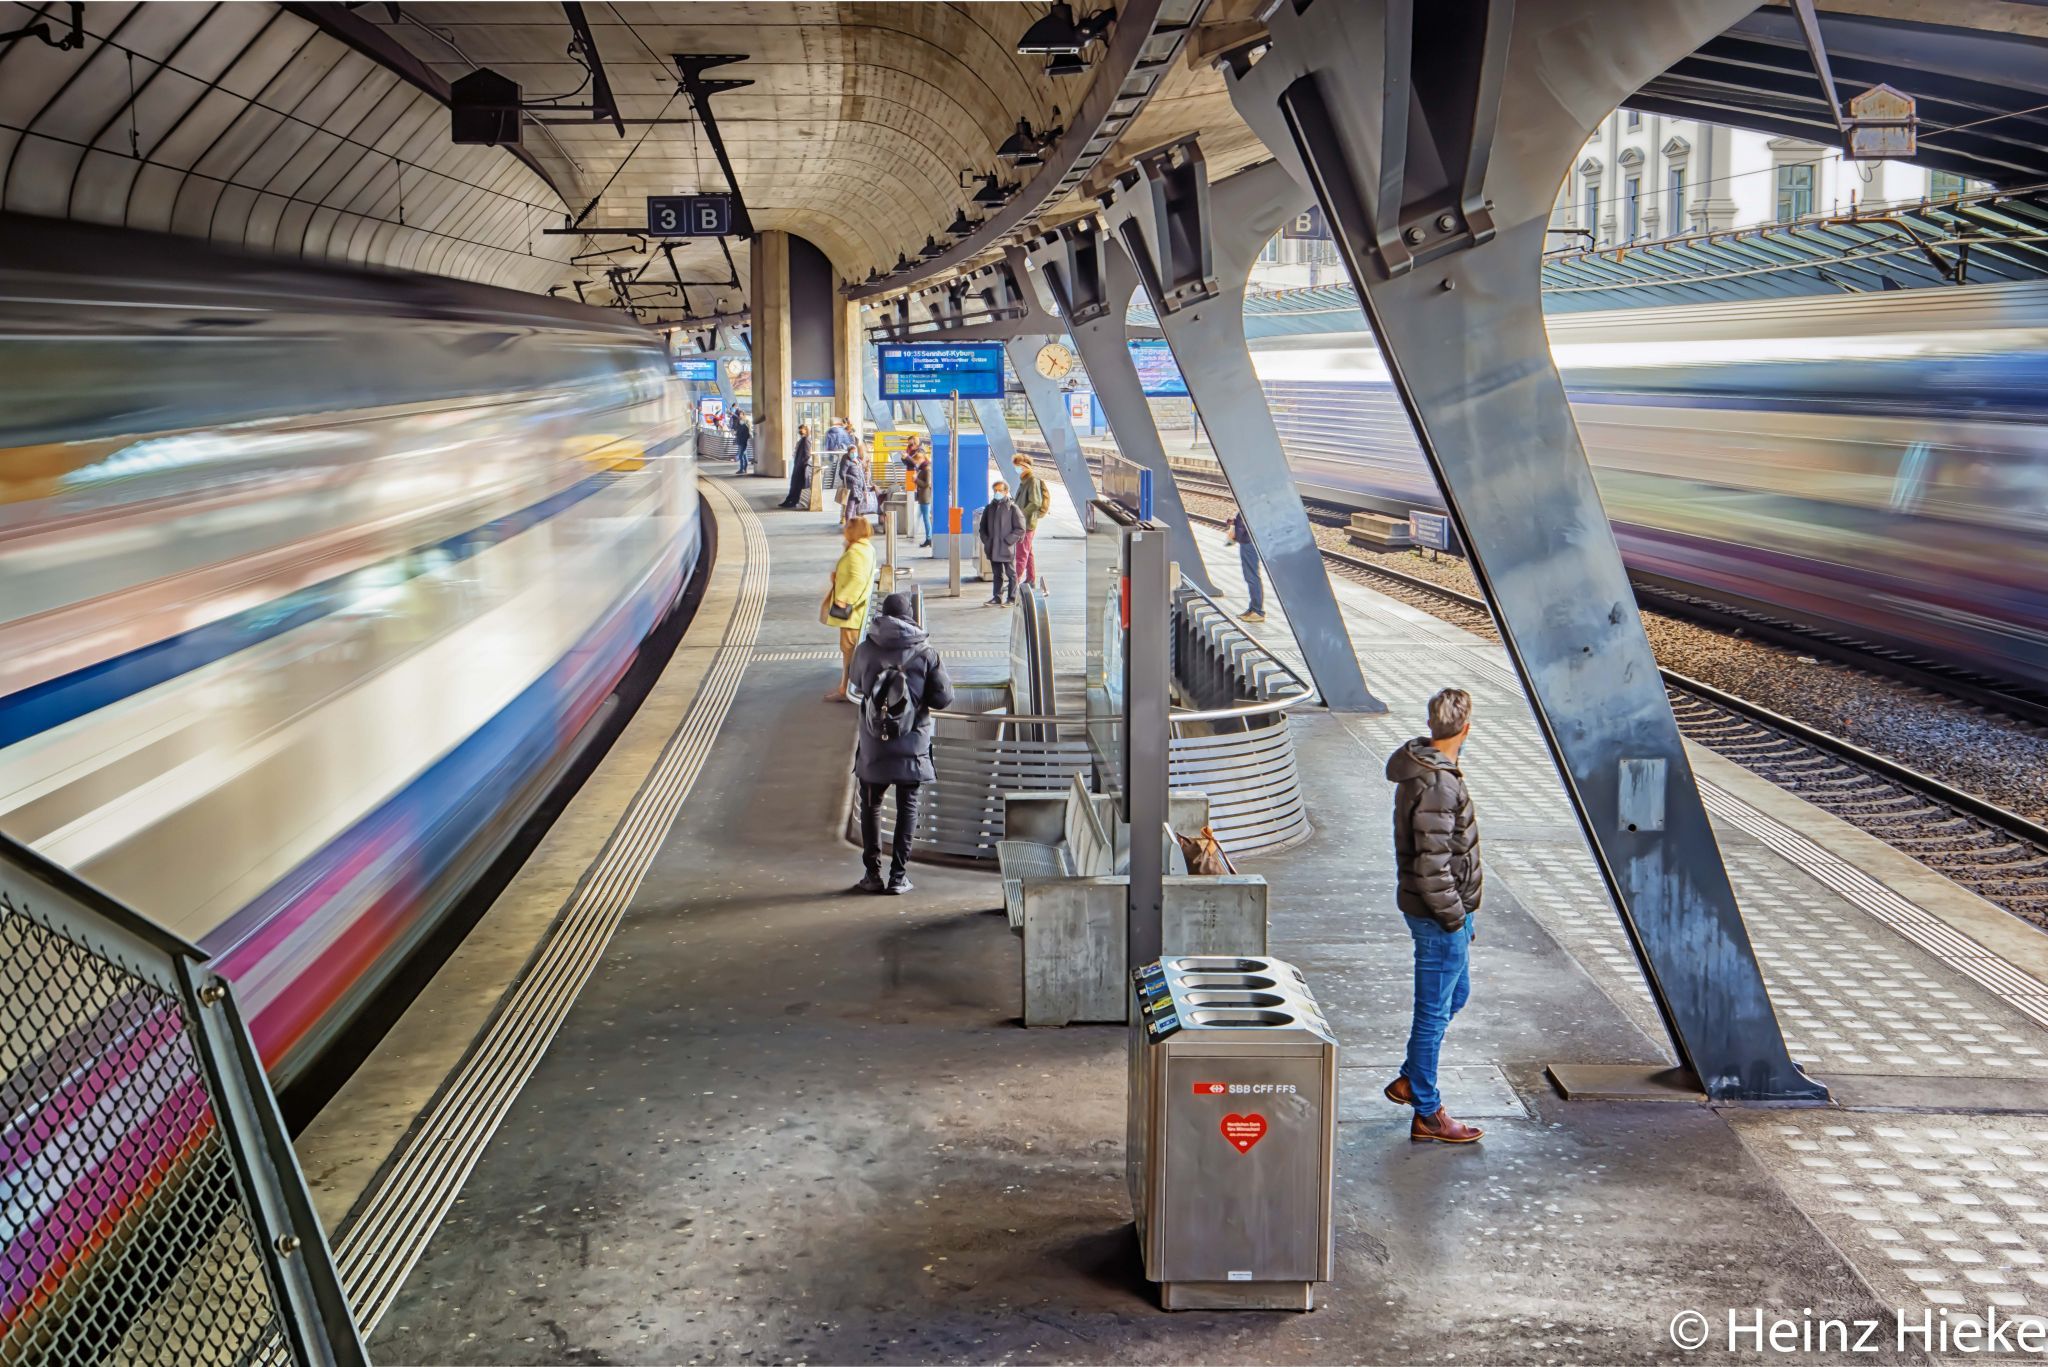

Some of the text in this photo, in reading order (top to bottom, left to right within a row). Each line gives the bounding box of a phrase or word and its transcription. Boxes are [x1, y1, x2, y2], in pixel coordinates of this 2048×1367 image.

[660, 208, 718, 229] 3 B
[1295, 213, 1312, 232] B
[921, 350, 975, 359] Sennhof-Kyburg
[1228, 1084, 1297, 1093] SBB CFF FFS
